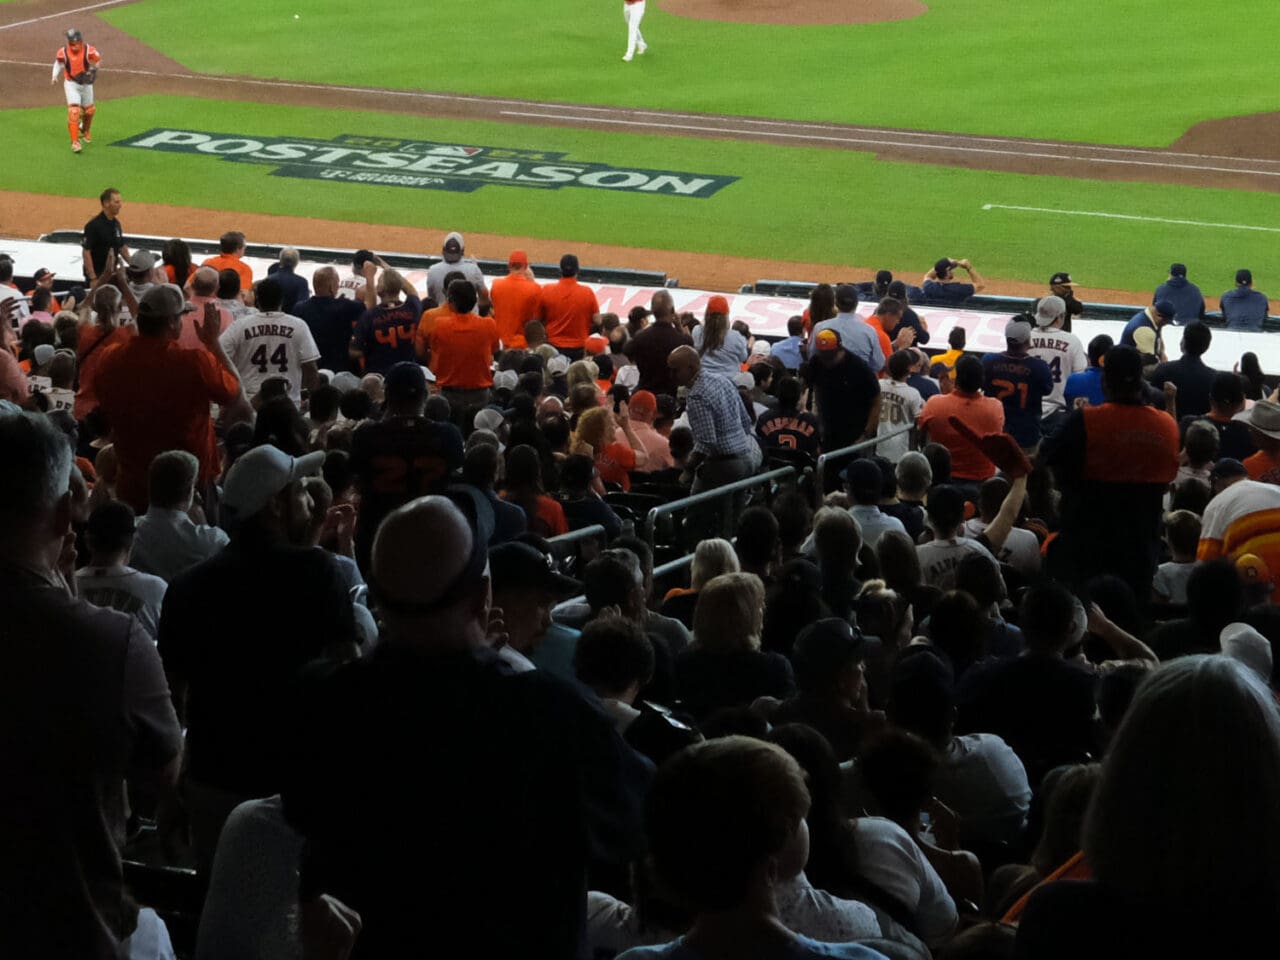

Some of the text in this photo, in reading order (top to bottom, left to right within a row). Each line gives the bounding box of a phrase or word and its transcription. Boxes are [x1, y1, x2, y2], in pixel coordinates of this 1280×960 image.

[131, 130, 715, 195] POSTSEASON
[244, 324, 295, 340] ALVAREZ
[375, 325, 416, 349] 44
[1028, 338, 1069, 352] VAREZ
[251, 343, 288, 373] 44
[929, 556, 958, 577] ALVA
